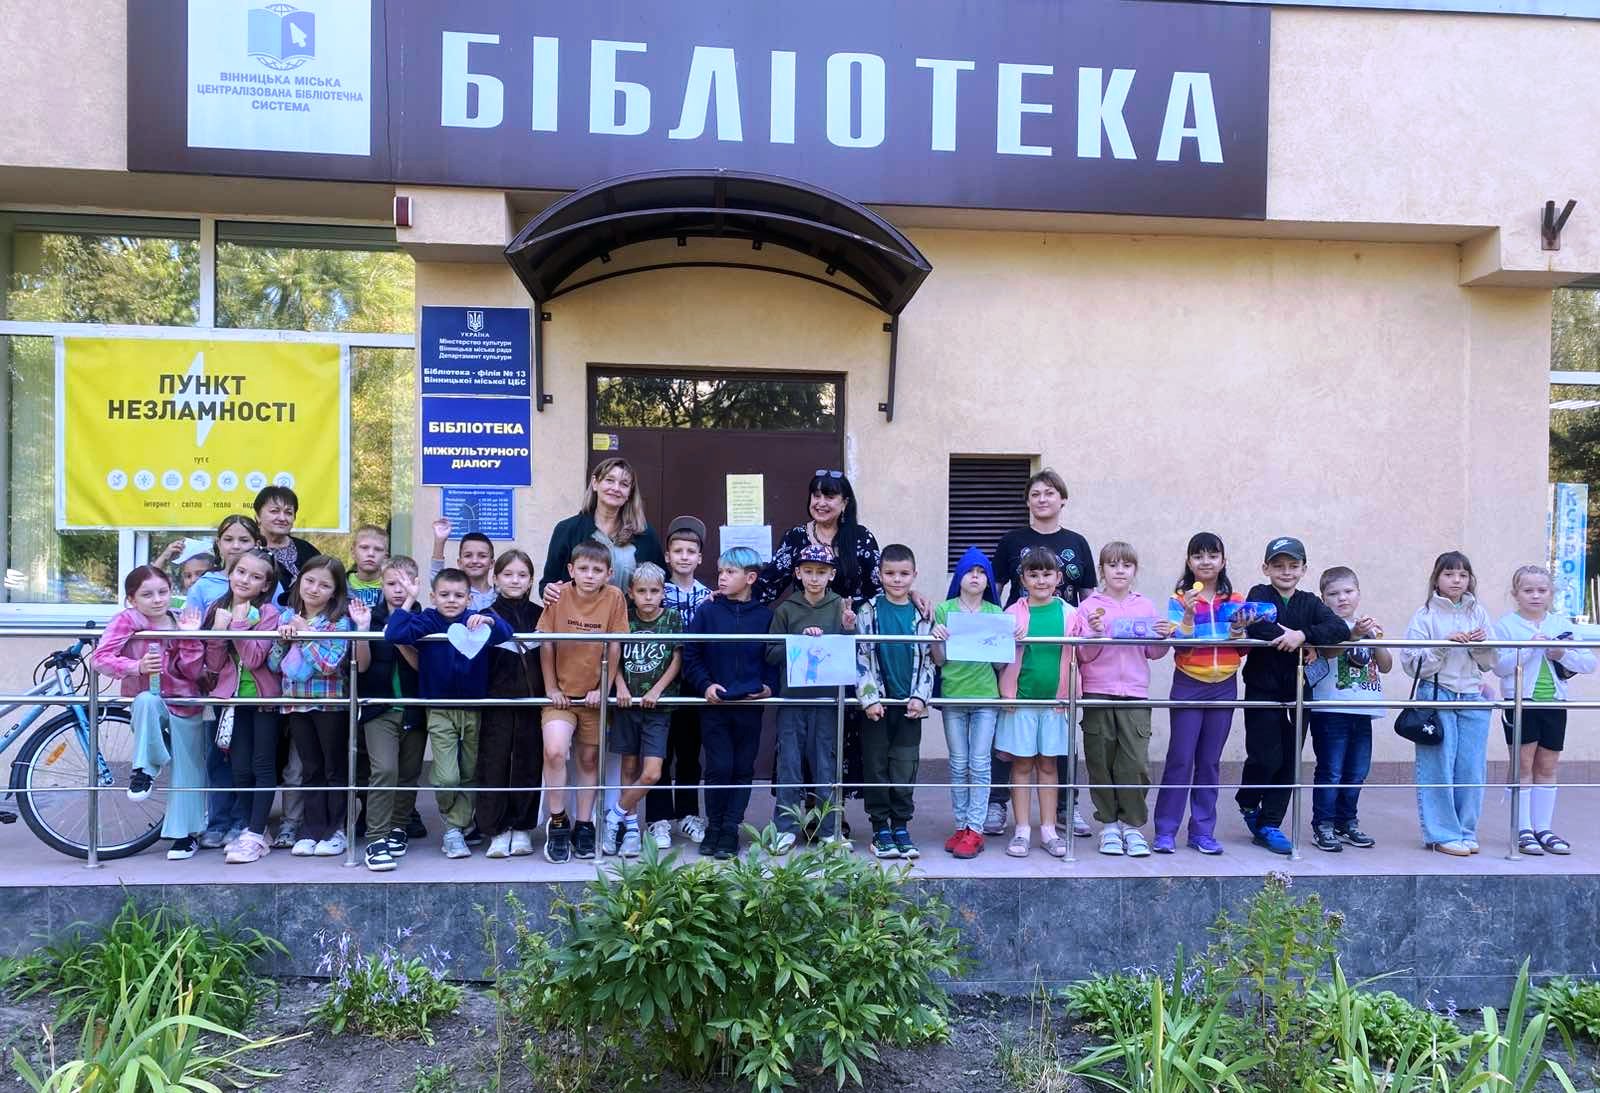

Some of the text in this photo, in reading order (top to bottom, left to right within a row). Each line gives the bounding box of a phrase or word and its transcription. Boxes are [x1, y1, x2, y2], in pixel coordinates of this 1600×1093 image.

[219, 72, 342, 89] ВІННИЦЬКА МІСЬКА
[196, 84, 364, 102] ЦЕНТРАЛІЗОВАНА БІБЛІОТЕЧНА
[440, 29, 1224, 165] БІБЛІОТЕКА
[251, 100, 311, 113] СИСТЕМА
[439, 338, 481, 346] Міністерство
[439, 345, 472, 353] Вінницька
[438, 352, 482, 360] Департамент
[424, 368, 470, 376] Бібліотека
[477, 369, 501, 377] філія
[516, 370, 526, 378] 13
[158, 374, 247, 396] ПУНКТ
[424, 376, 527, 387] Вінницької міської ЦБС
[107, 399, 296, 423] НЕЗЛАМНОСТІ
[428, 422, 524, 435] БІБЛІОТЕКА
[423, 447, 529, 457] МІЖКУЛЬТУРНОГО
[193, 456, 204, 464] тут
[451, 459, 502, 470] ДІАЛОГУ
[143, 500, 171, 509] інтернет
[181, 500, 202, 509] світло
[213, 501, 232, 509] тепло
